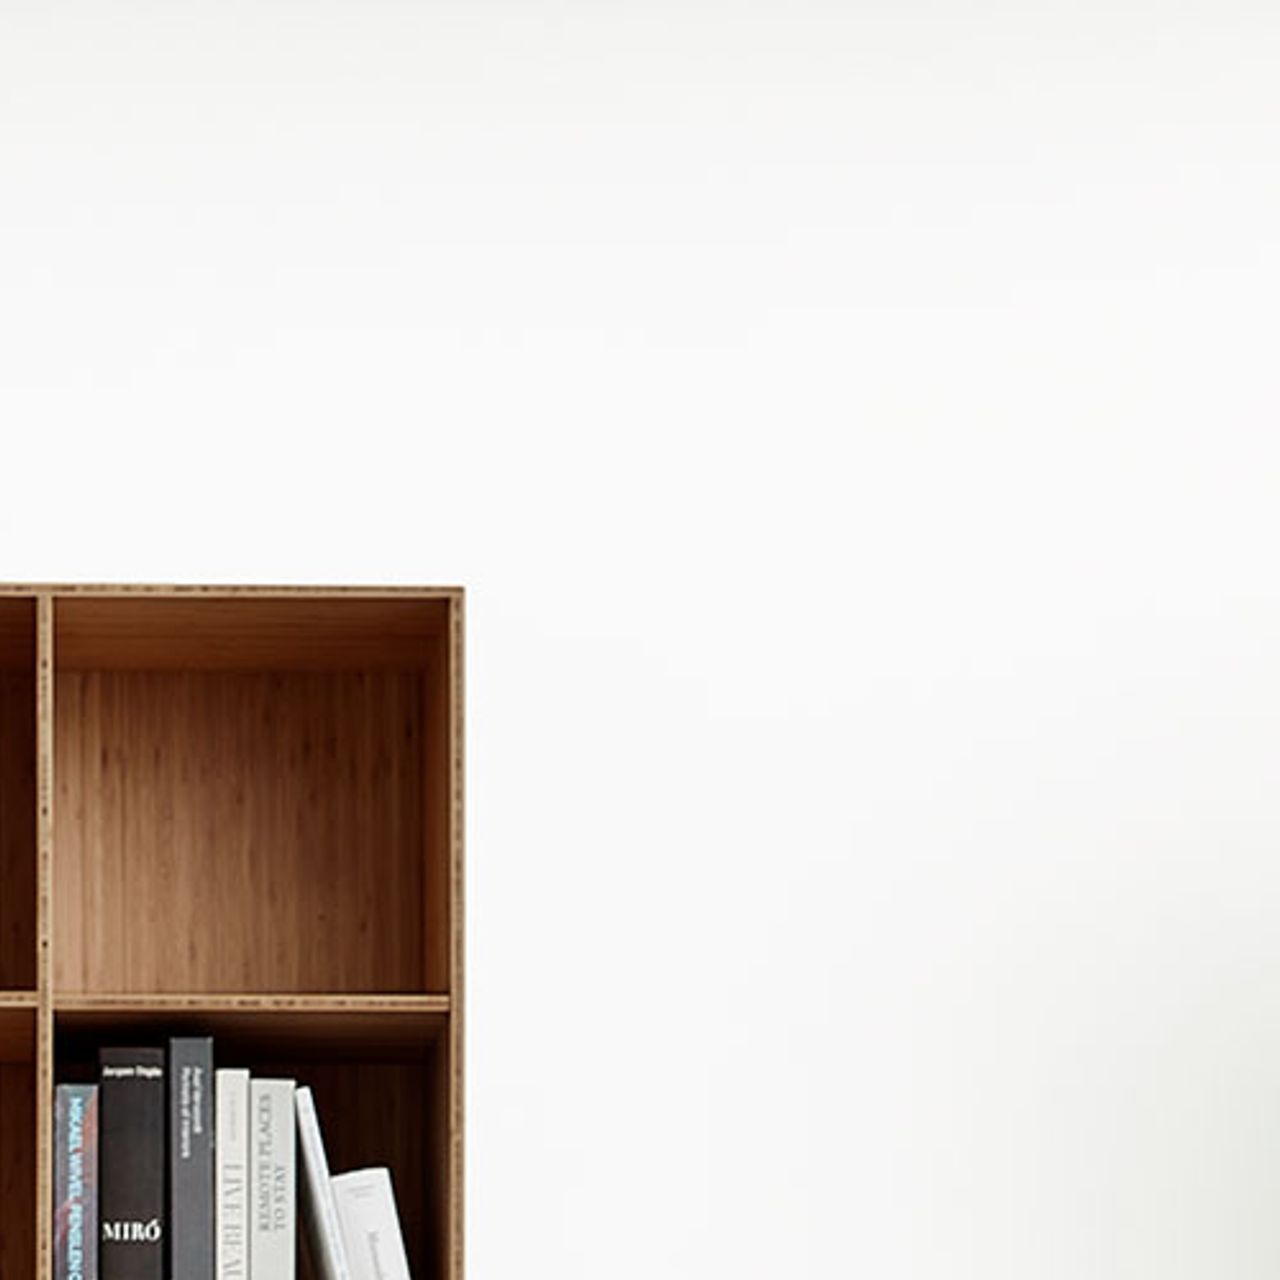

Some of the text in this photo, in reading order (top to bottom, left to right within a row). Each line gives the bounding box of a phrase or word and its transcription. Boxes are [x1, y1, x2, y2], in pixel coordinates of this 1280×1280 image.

[223, 1164, 243, 1219] LIVE
[259, 1094, 271, 1231] REMOTE PLACES
[274, 1165, 286, 1231] TO STAY
[102, 1219, 162, 1241] MIRÓ
